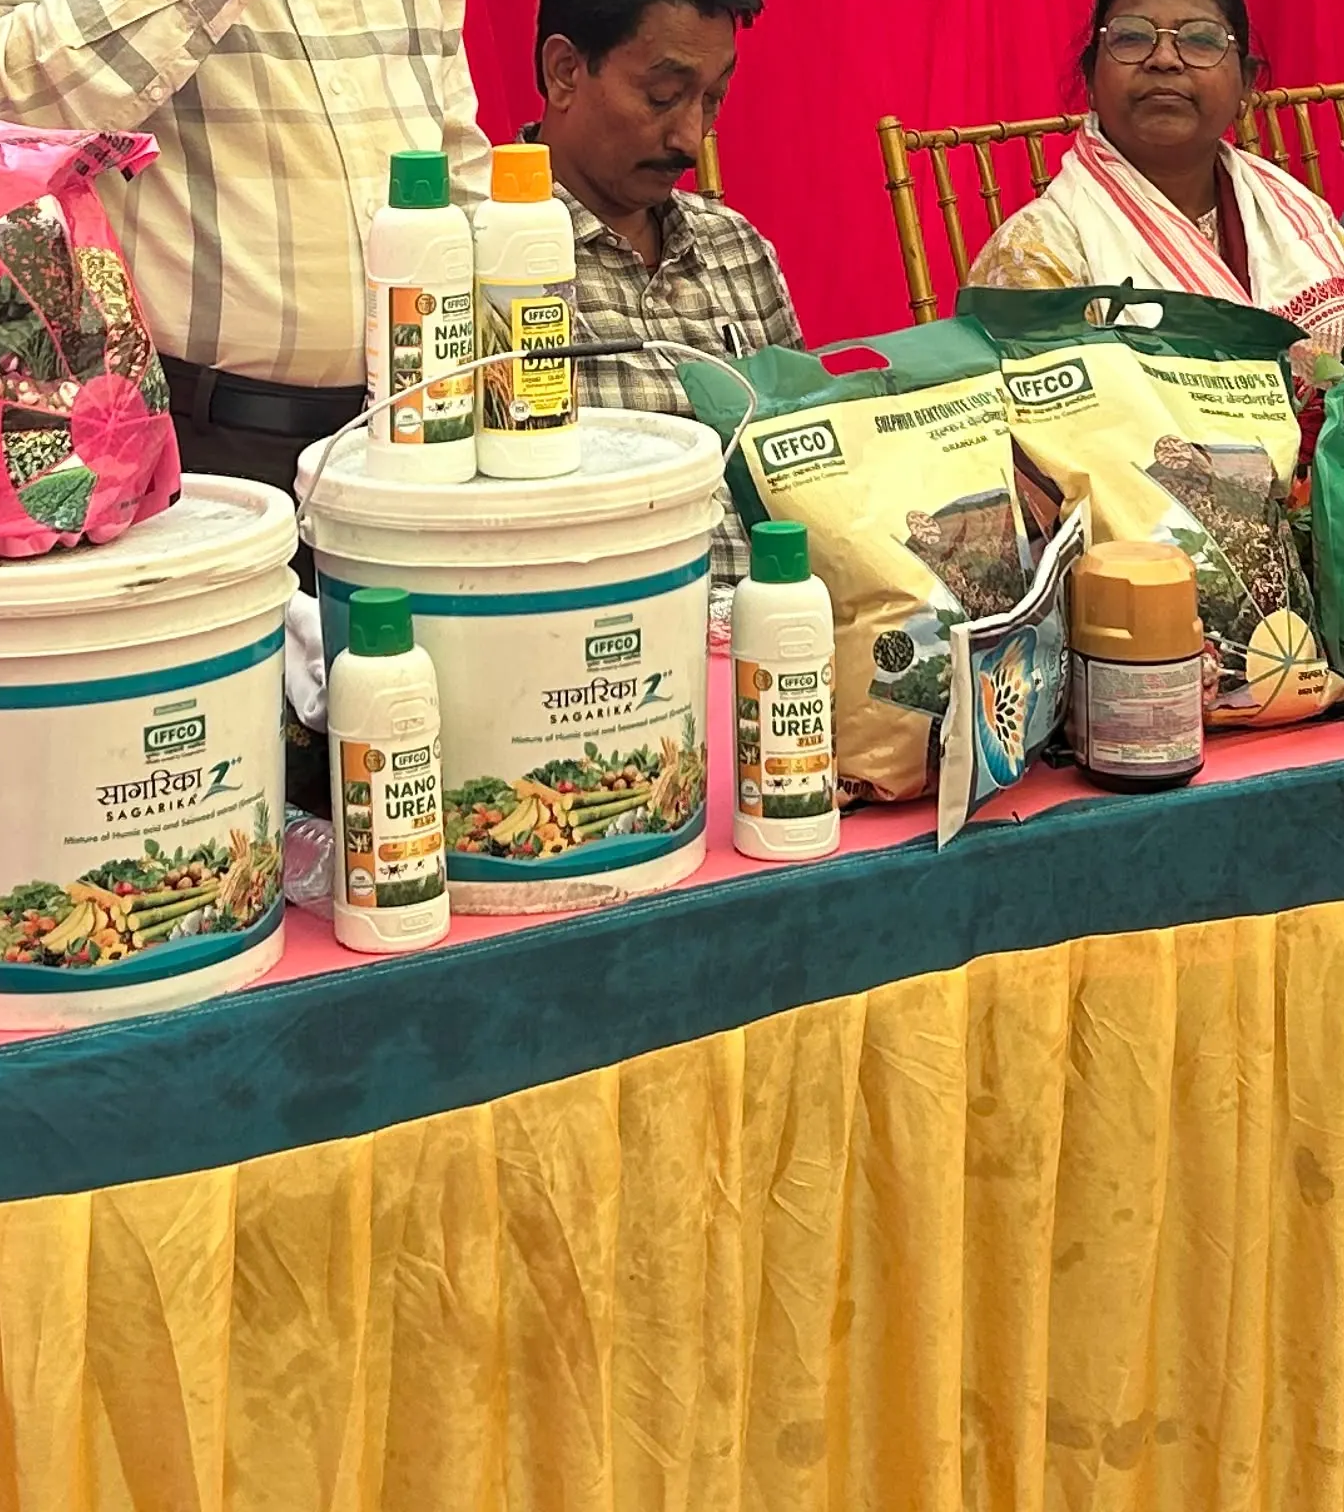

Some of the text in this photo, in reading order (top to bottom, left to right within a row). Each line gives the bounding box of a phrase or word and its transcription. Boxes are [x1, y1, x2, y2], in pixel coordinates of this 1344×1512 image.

[529, 309, 558, 320] IFFCO
[521, 334, 564, 350] NANO
[1016, 371, 1073, 397] IFFCO
[771, 431, 825, 461] IFFCO
[594, 637, 633, 654] IFFCO
[542, 677, 637, 709] सागरिका
[772, 699, 823, 718] NANO
[154, 723, 197, 745] IFFCO
[772, 717, 824, 736] UREA
[399, 751, 425, 765] IFFCO
[96, 767, 202, 805] सागरिका
[385, 775, 435, 799] NANO
[386, 793, 436, 819] UREA
[64, 835, 98, 845] Mixture
[101, 832, 110, 841] of
[163, 820, 179, 831] and
